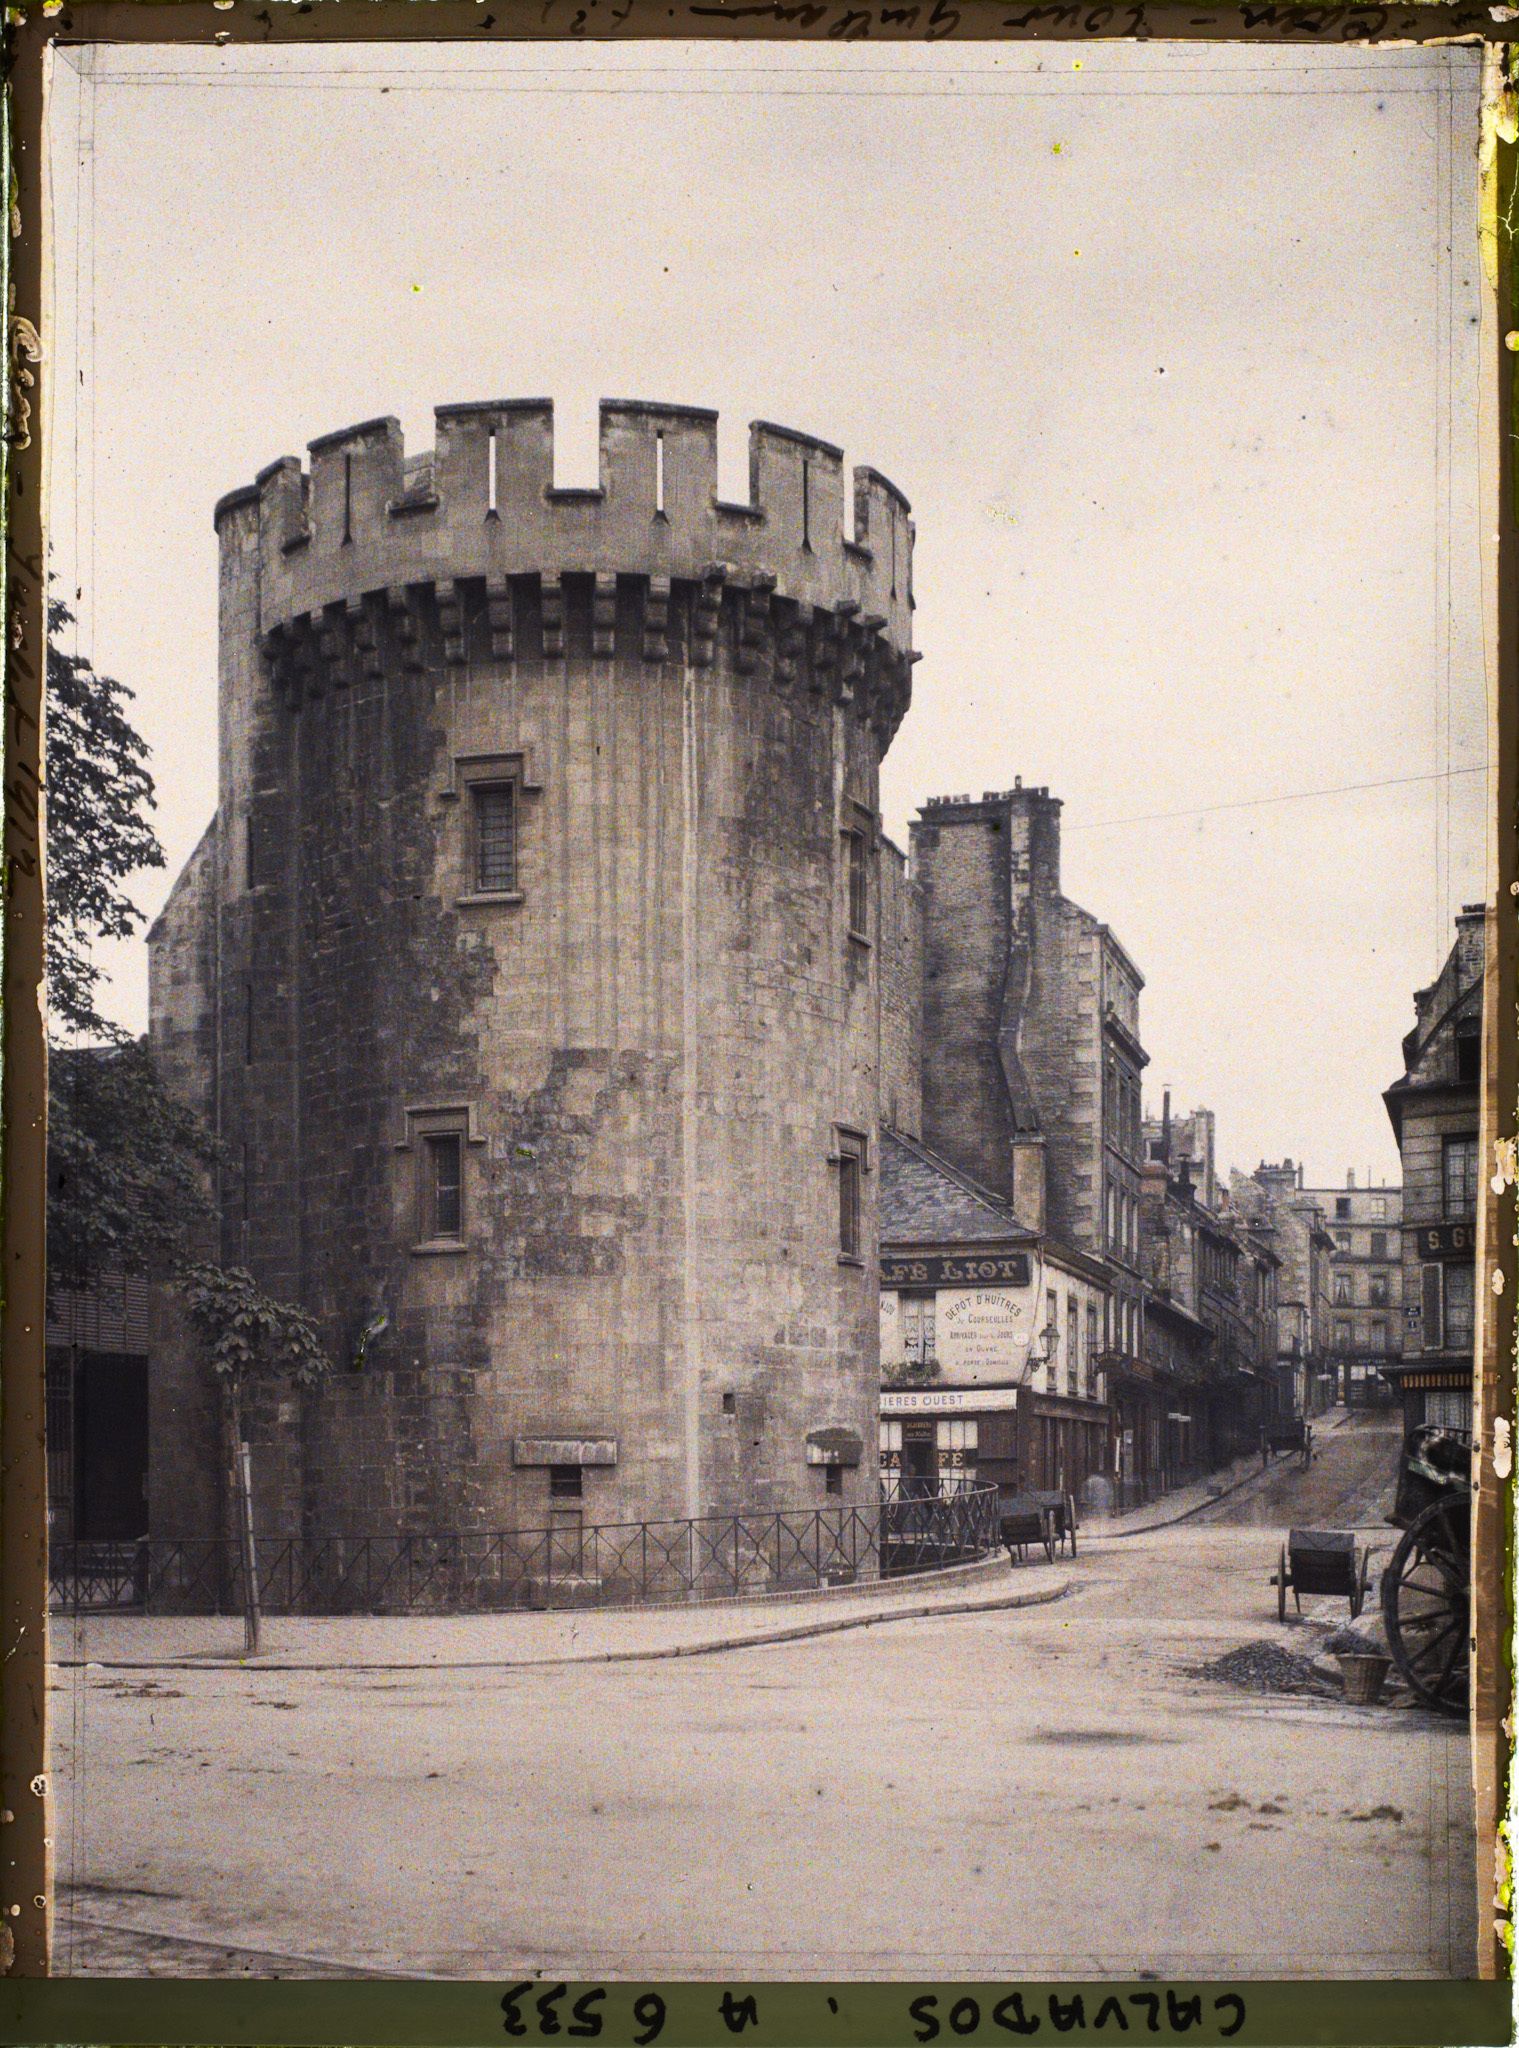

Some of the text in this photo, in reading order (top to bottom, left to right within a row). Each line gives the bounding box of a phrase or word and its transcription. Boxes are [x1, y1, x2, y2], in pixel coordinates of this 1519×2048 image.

[940, 1260, 1018, 1280] LIOT
[922, 1394, 964, 1406] OUEST
[909, 1990, 1246, 2042] CALVADOS
